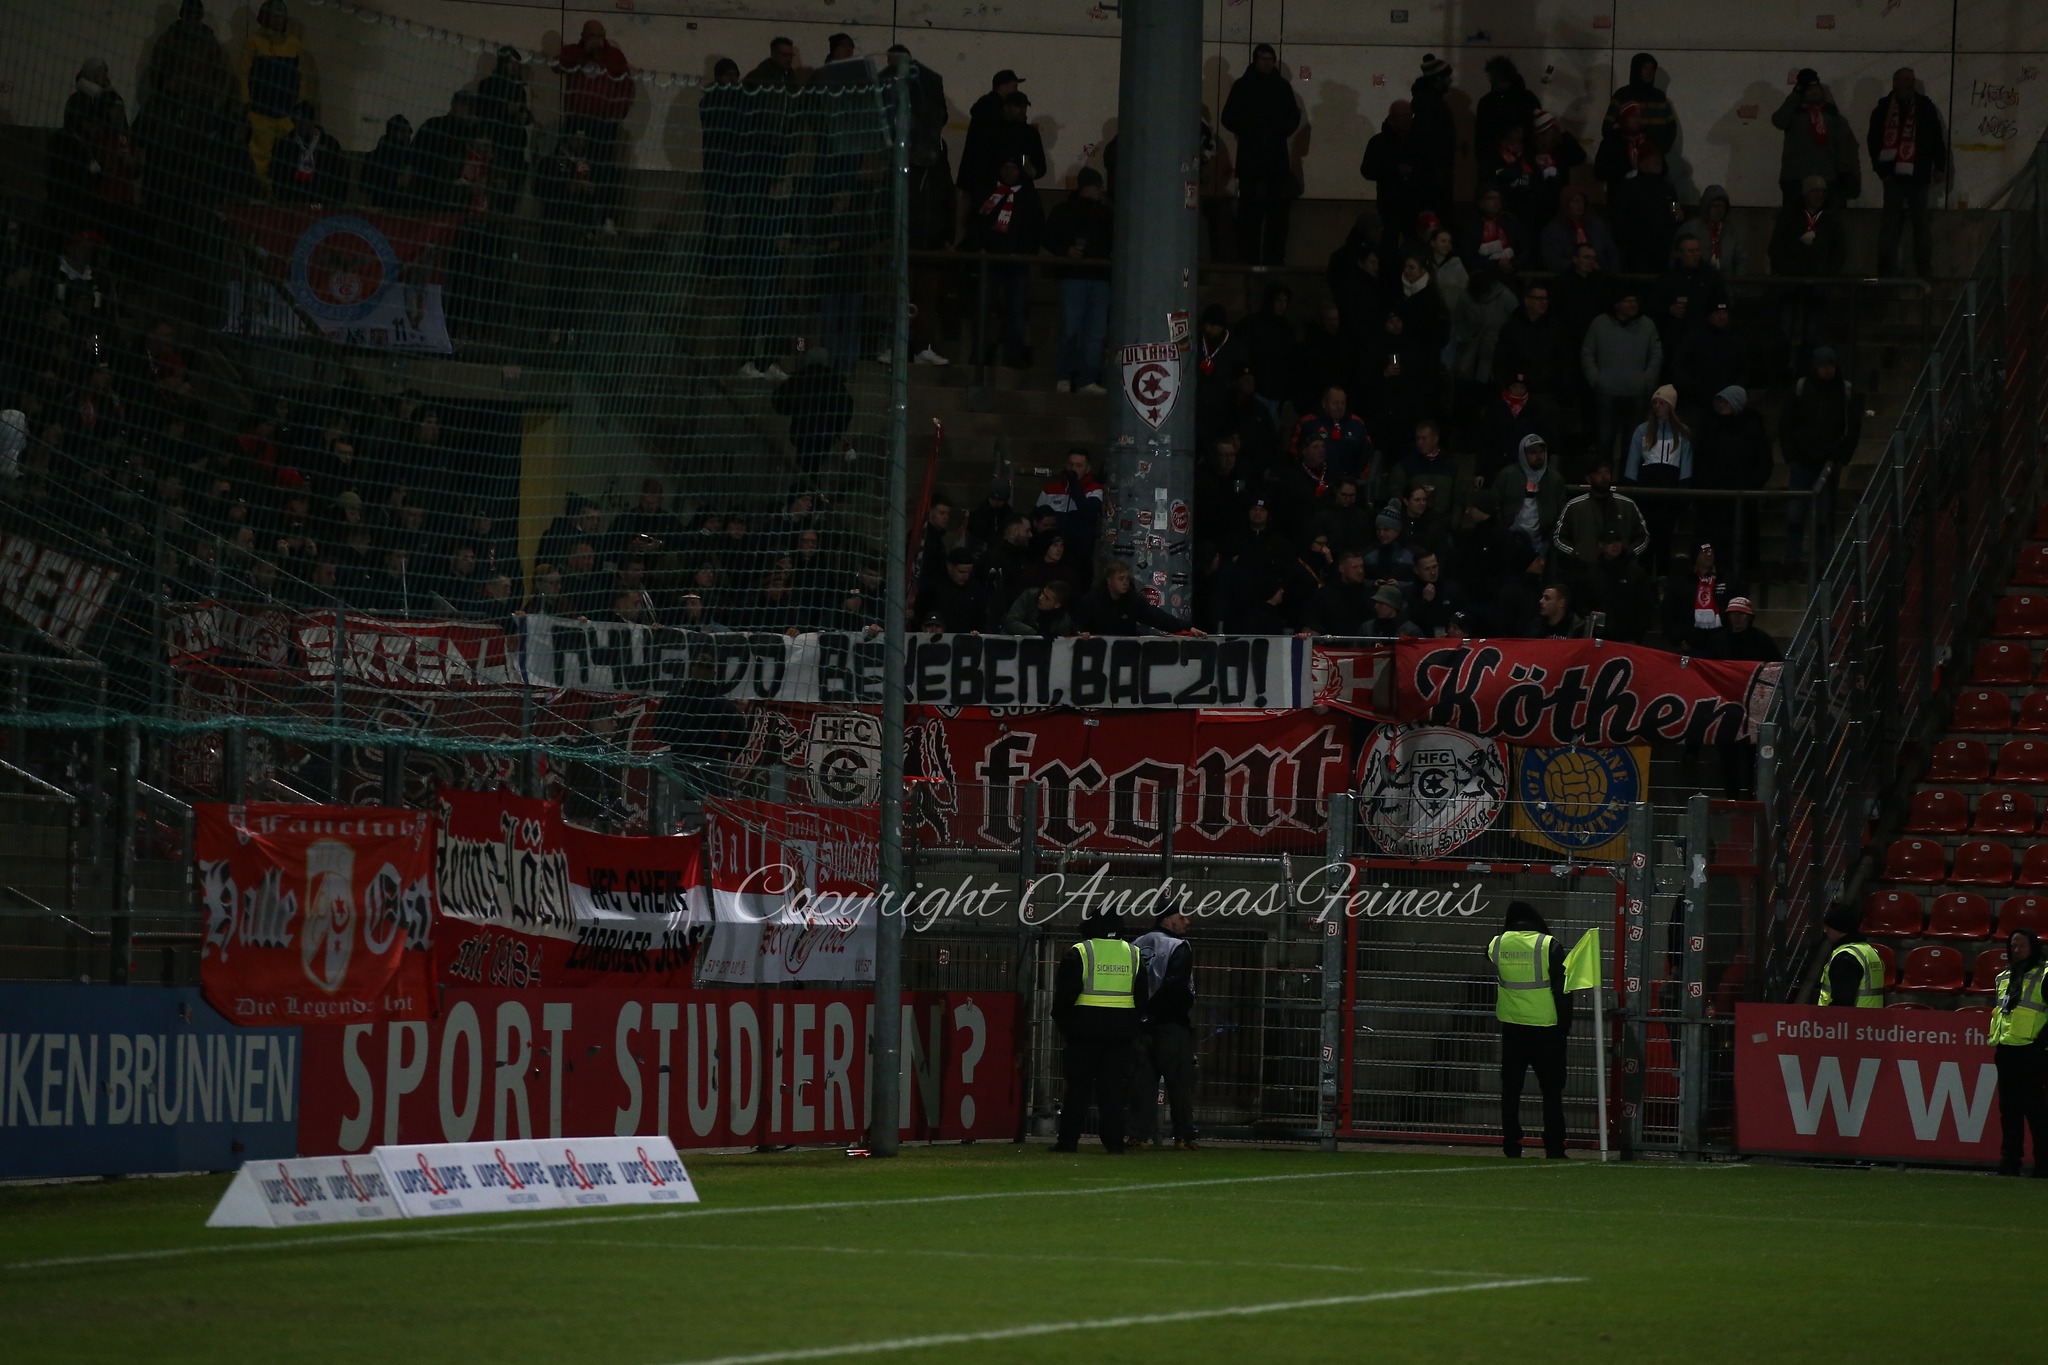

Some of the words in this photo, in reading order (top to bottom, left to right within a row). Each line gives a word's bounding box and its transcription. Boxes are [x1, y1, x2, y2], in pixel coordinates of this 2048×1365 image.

[1125, 344, 1176, 362] ULTRAS
[1415, 646, 1752, 746] Köthen
[820, 719, 872, 743] HFC
[1417, 752, 1450, 765] HFC
[976, 725, 1343, 848] front
[256, 814, 414, 836] Fanclub
[1439, 808, 1490, 852] Schlag
[586, 866, 621, 911] HFC
[1097, 964, 1130, 973] SICHERHEIT
[235, 997, 276, 1016] Die
[1776, 1021, 1848, 1040] Fußball
[1856, 1025, 1957, 1045] studieren:
[107, 1033, 296, 1125] BRUNNEN
[338, 1001, 572, 1151] SPORT
[614, 1001, 986, 1136] STUDIERN?
